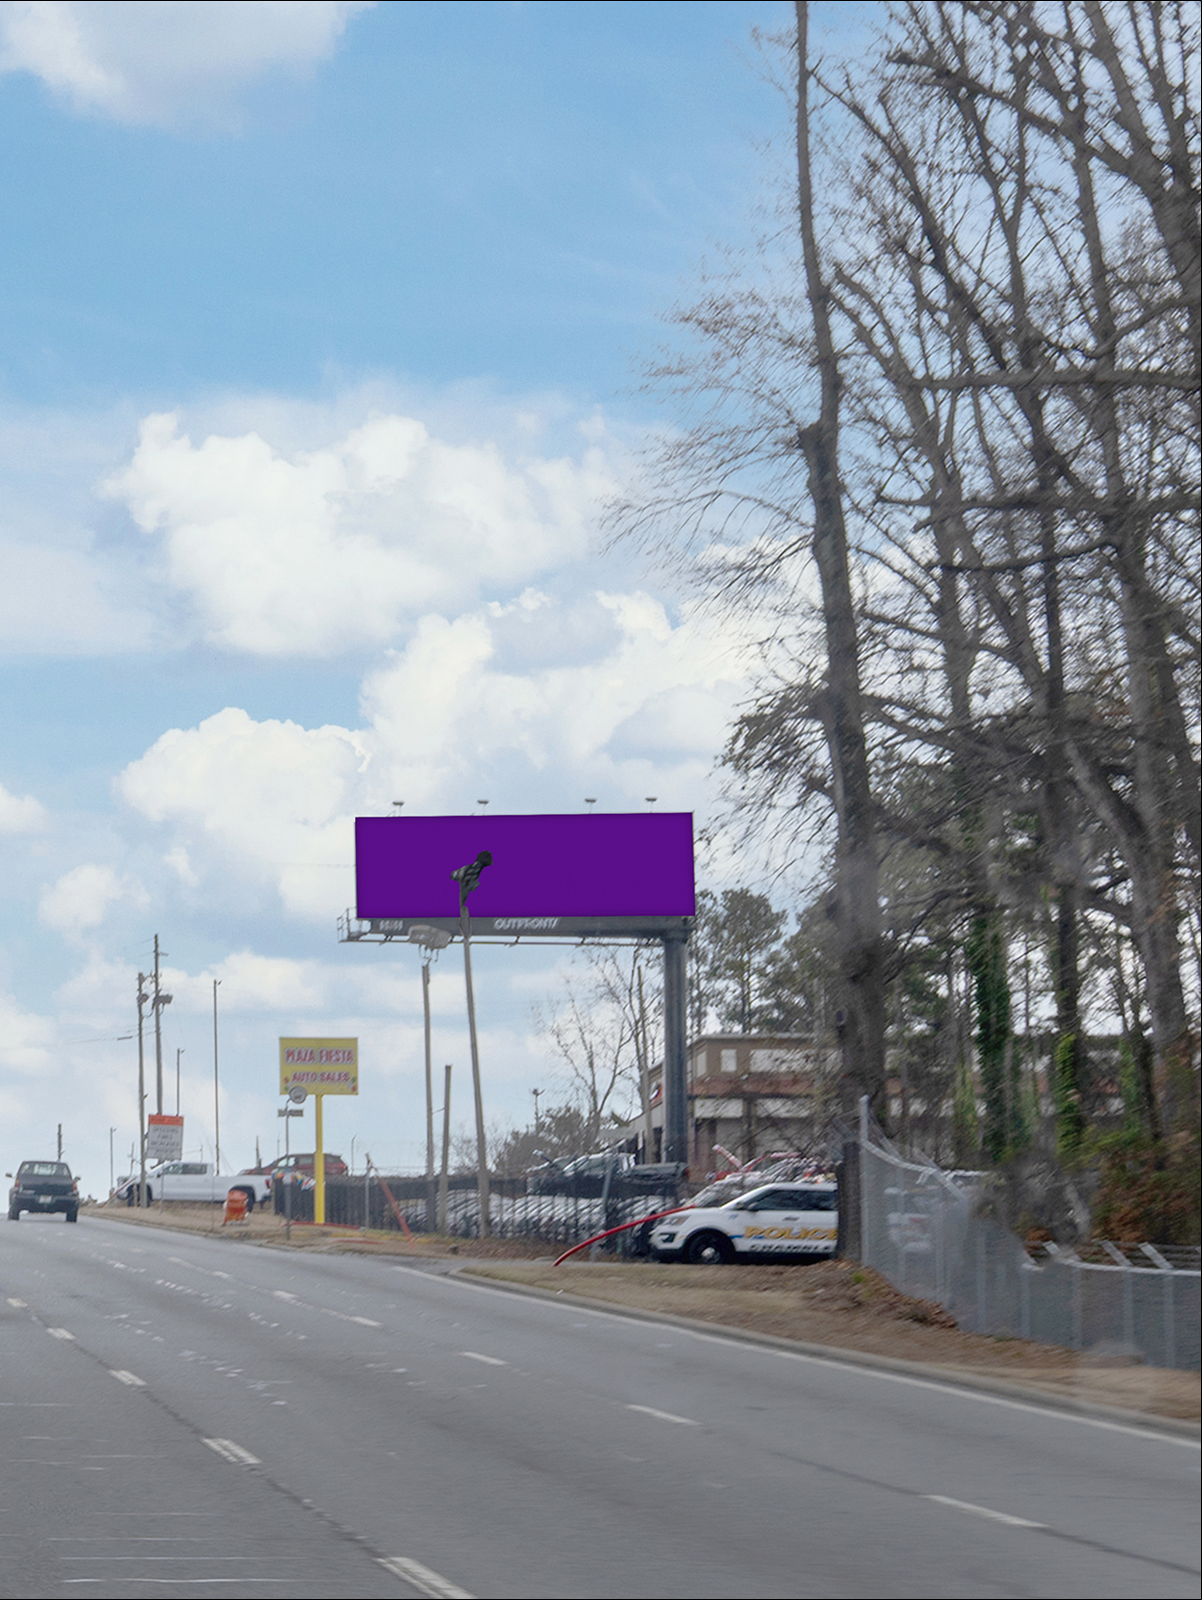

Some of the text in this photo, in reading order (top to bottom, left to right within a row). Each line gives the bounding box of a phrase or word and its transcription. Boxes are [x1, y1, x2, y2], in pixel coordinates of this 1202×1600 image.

[285, 1048, 354, 1064] PLAZA FIESTA
[291, 1071, 350, 1083] AUTO SALES
[743, 1226, 838, 1240] POLICE
[750, 1243, 834, 1252] CHAMBLE
